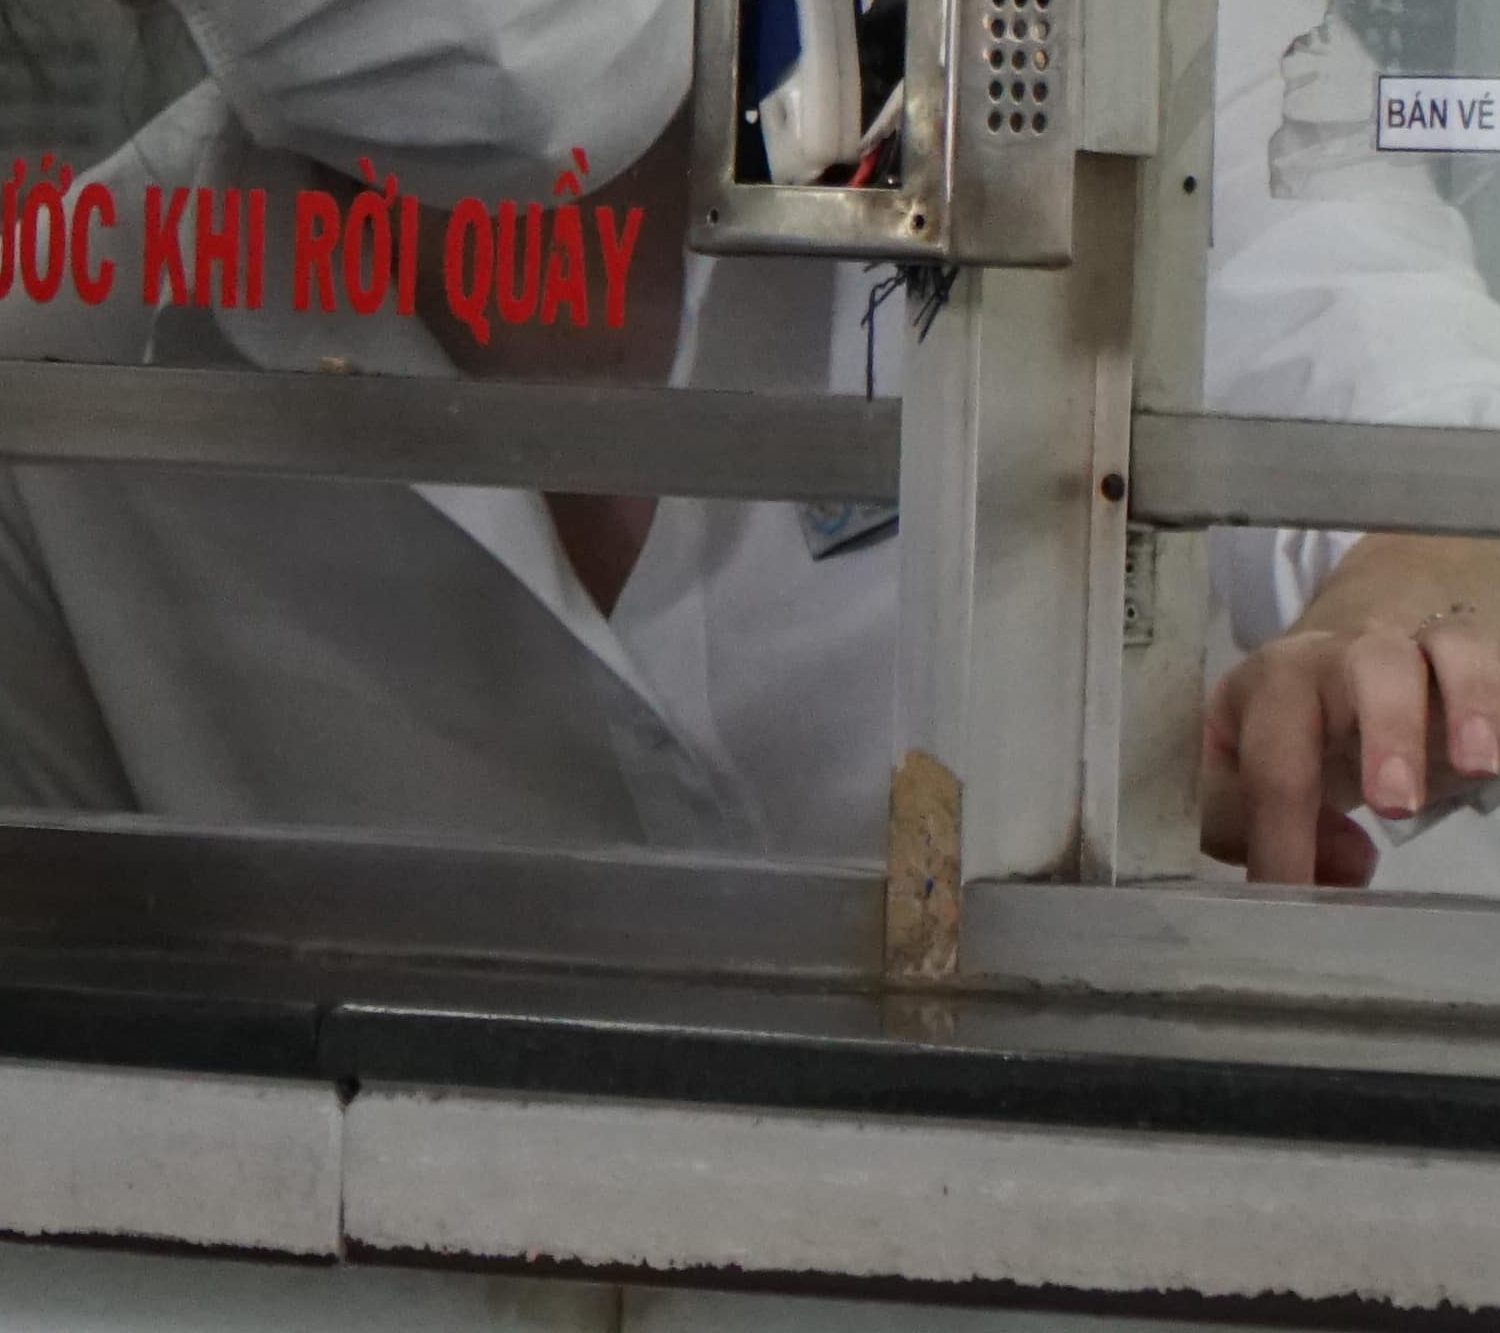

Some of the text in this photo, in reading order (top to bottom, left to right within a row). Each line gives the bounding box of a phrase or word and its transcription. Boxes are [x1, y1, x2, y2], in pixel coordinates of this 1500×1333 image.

[1387, 92, 1447, 129] BÁN
[1457, 93, 1495, 129] VÉ
[142, 184, 266, 310] KHI
[292, 156, 419, 317] RỜI
[444, 146, 645, 346] QUẦY
